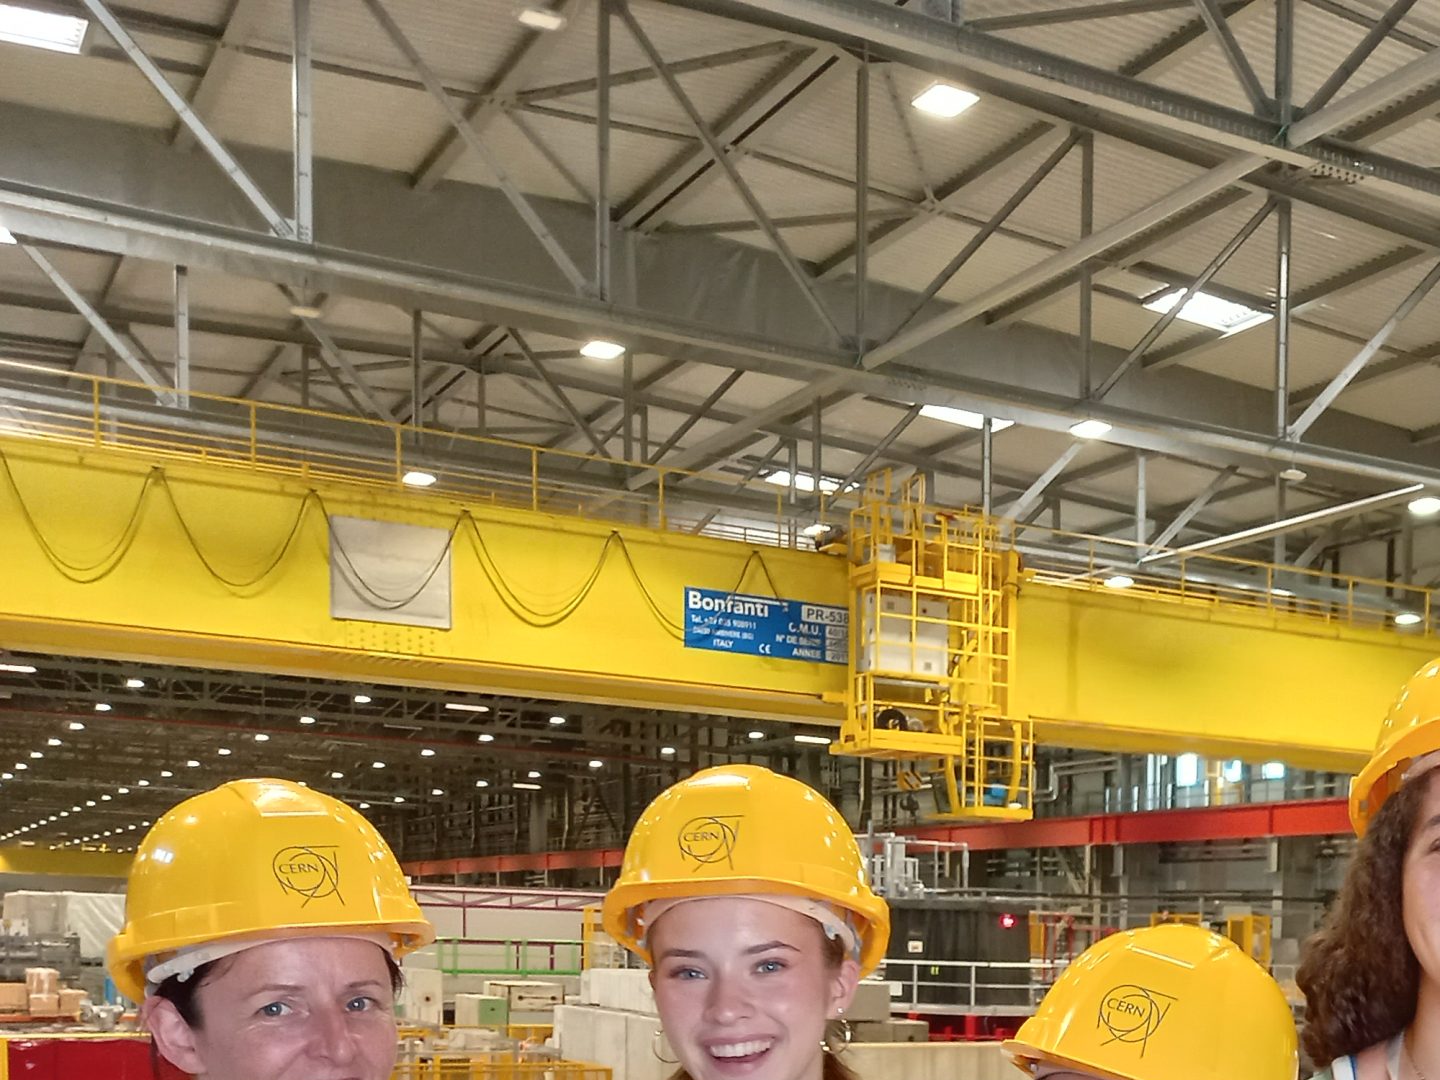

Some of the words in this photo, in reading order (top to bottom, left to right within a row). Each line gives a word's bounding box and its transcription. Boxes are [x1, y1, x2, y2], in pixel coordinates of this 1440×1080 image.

[713, 638, 734, 649] ITALY
[684, 831, 720, 842] CERN
[279, 863, 319, 875] CERN
[1106, 997, 1146, 1018] CERN
